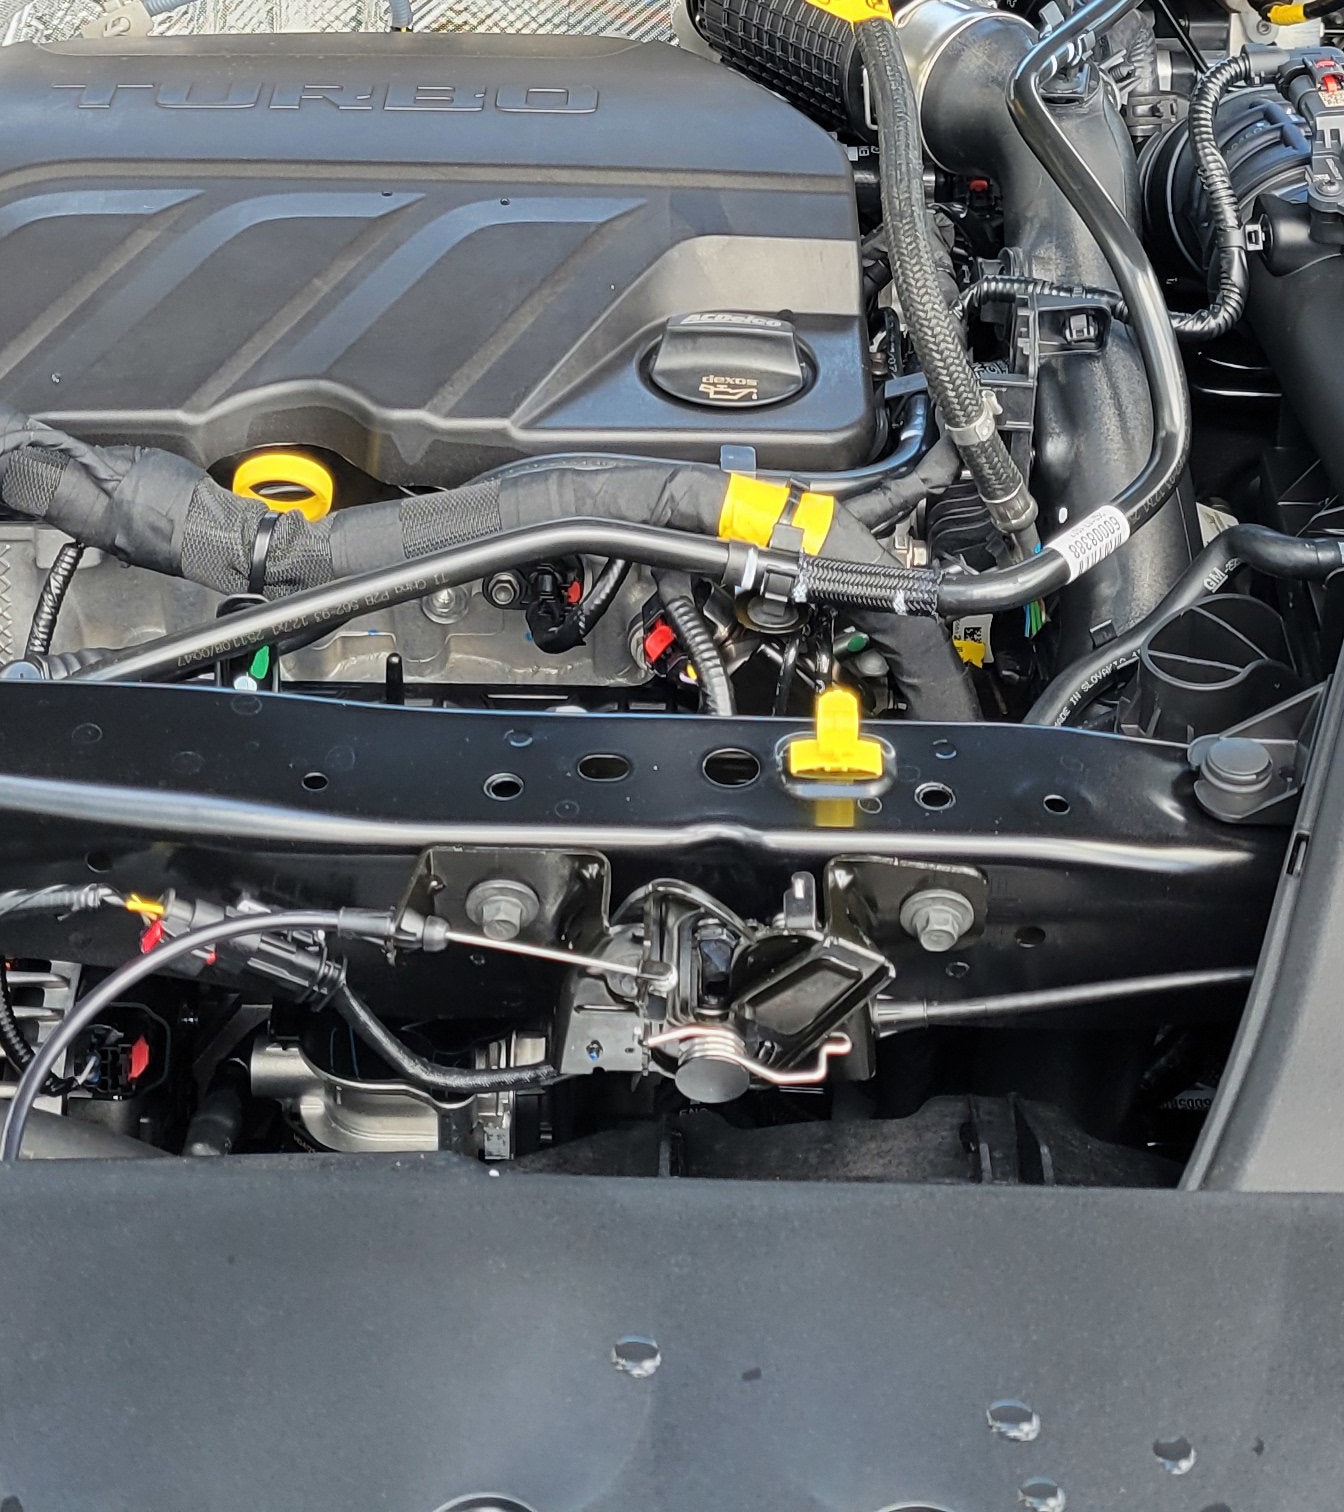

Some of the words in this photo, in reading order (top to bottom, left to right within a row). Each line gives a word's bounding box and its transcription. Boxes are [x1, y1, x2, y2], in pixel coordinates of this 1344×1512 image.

[52, 84, 600, 115] TURBO
[680, 313, 782, 327] ACDelco
[701, 374, 758, 386] dexos
[1068, 515, 1121, 559] 60008388
[1069, 691, 1082, 706] IN
